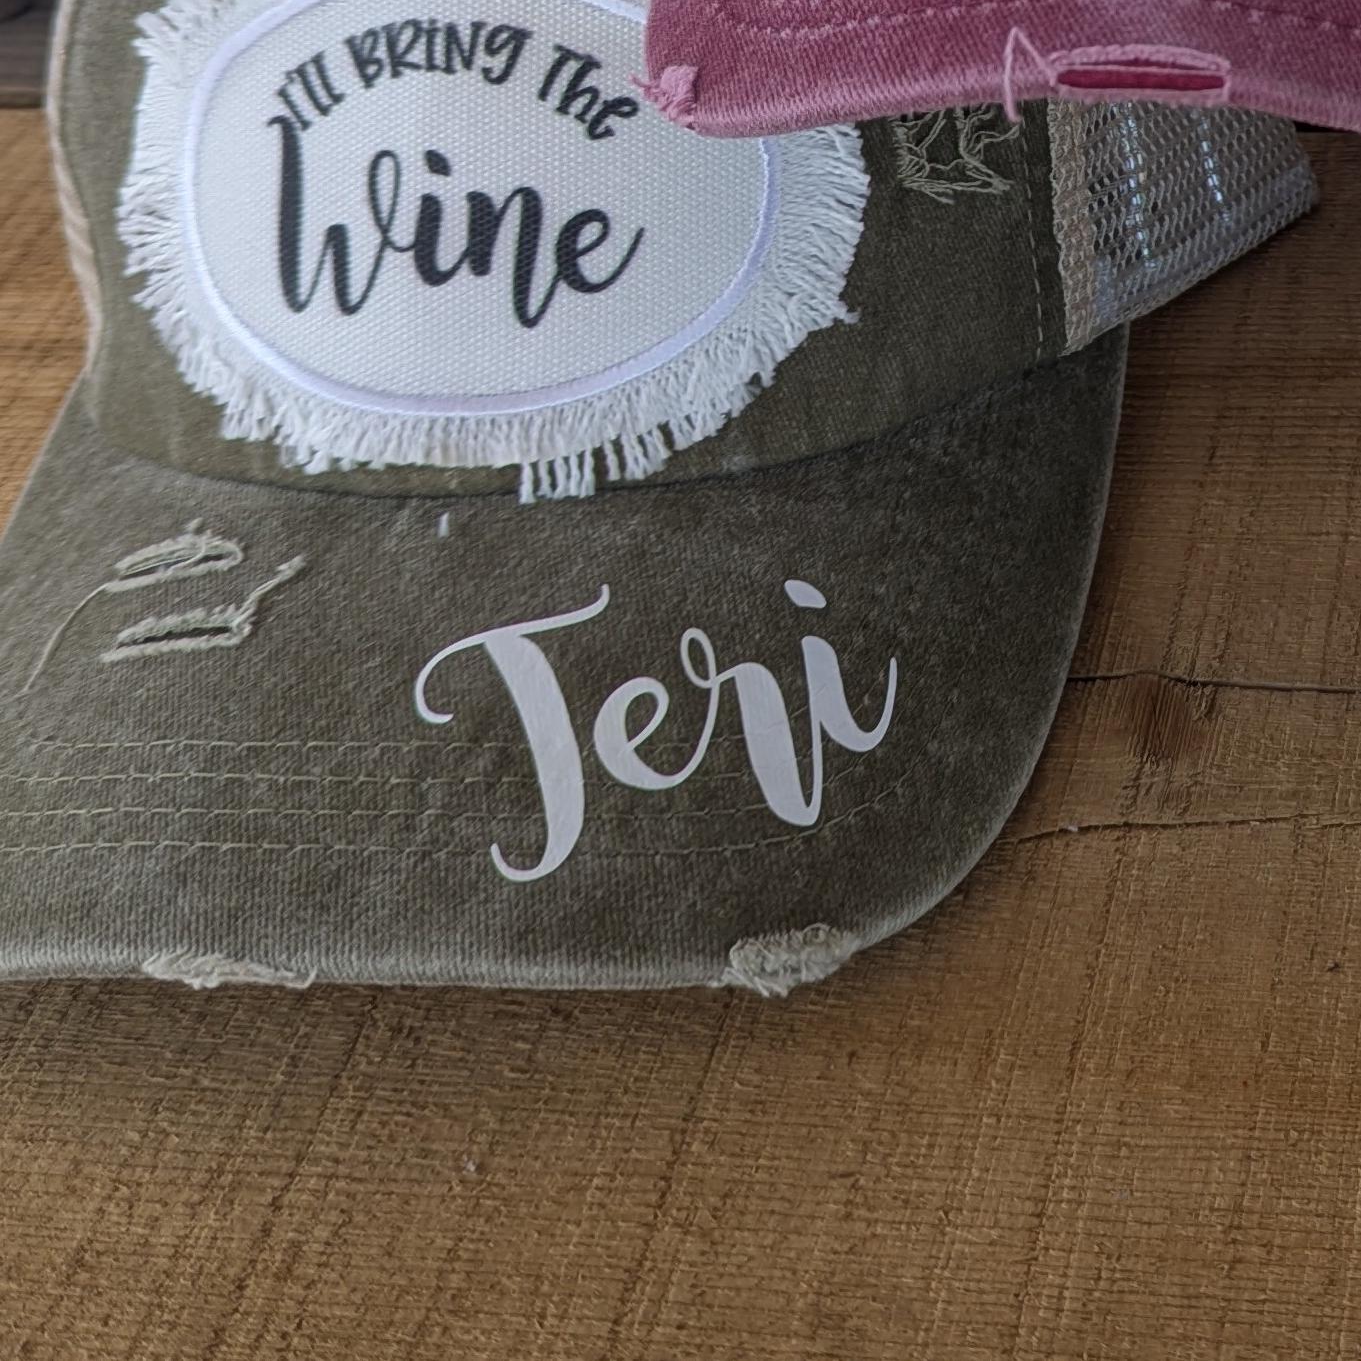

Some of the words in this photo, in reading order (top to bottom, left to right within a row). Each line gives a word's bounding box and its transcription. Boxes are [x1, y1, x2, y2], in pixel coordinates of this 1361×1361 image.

[537, 44, 640, 140] The
[266, 115, 646, 329] Wine
[413, 578, 897, 883] Teri
